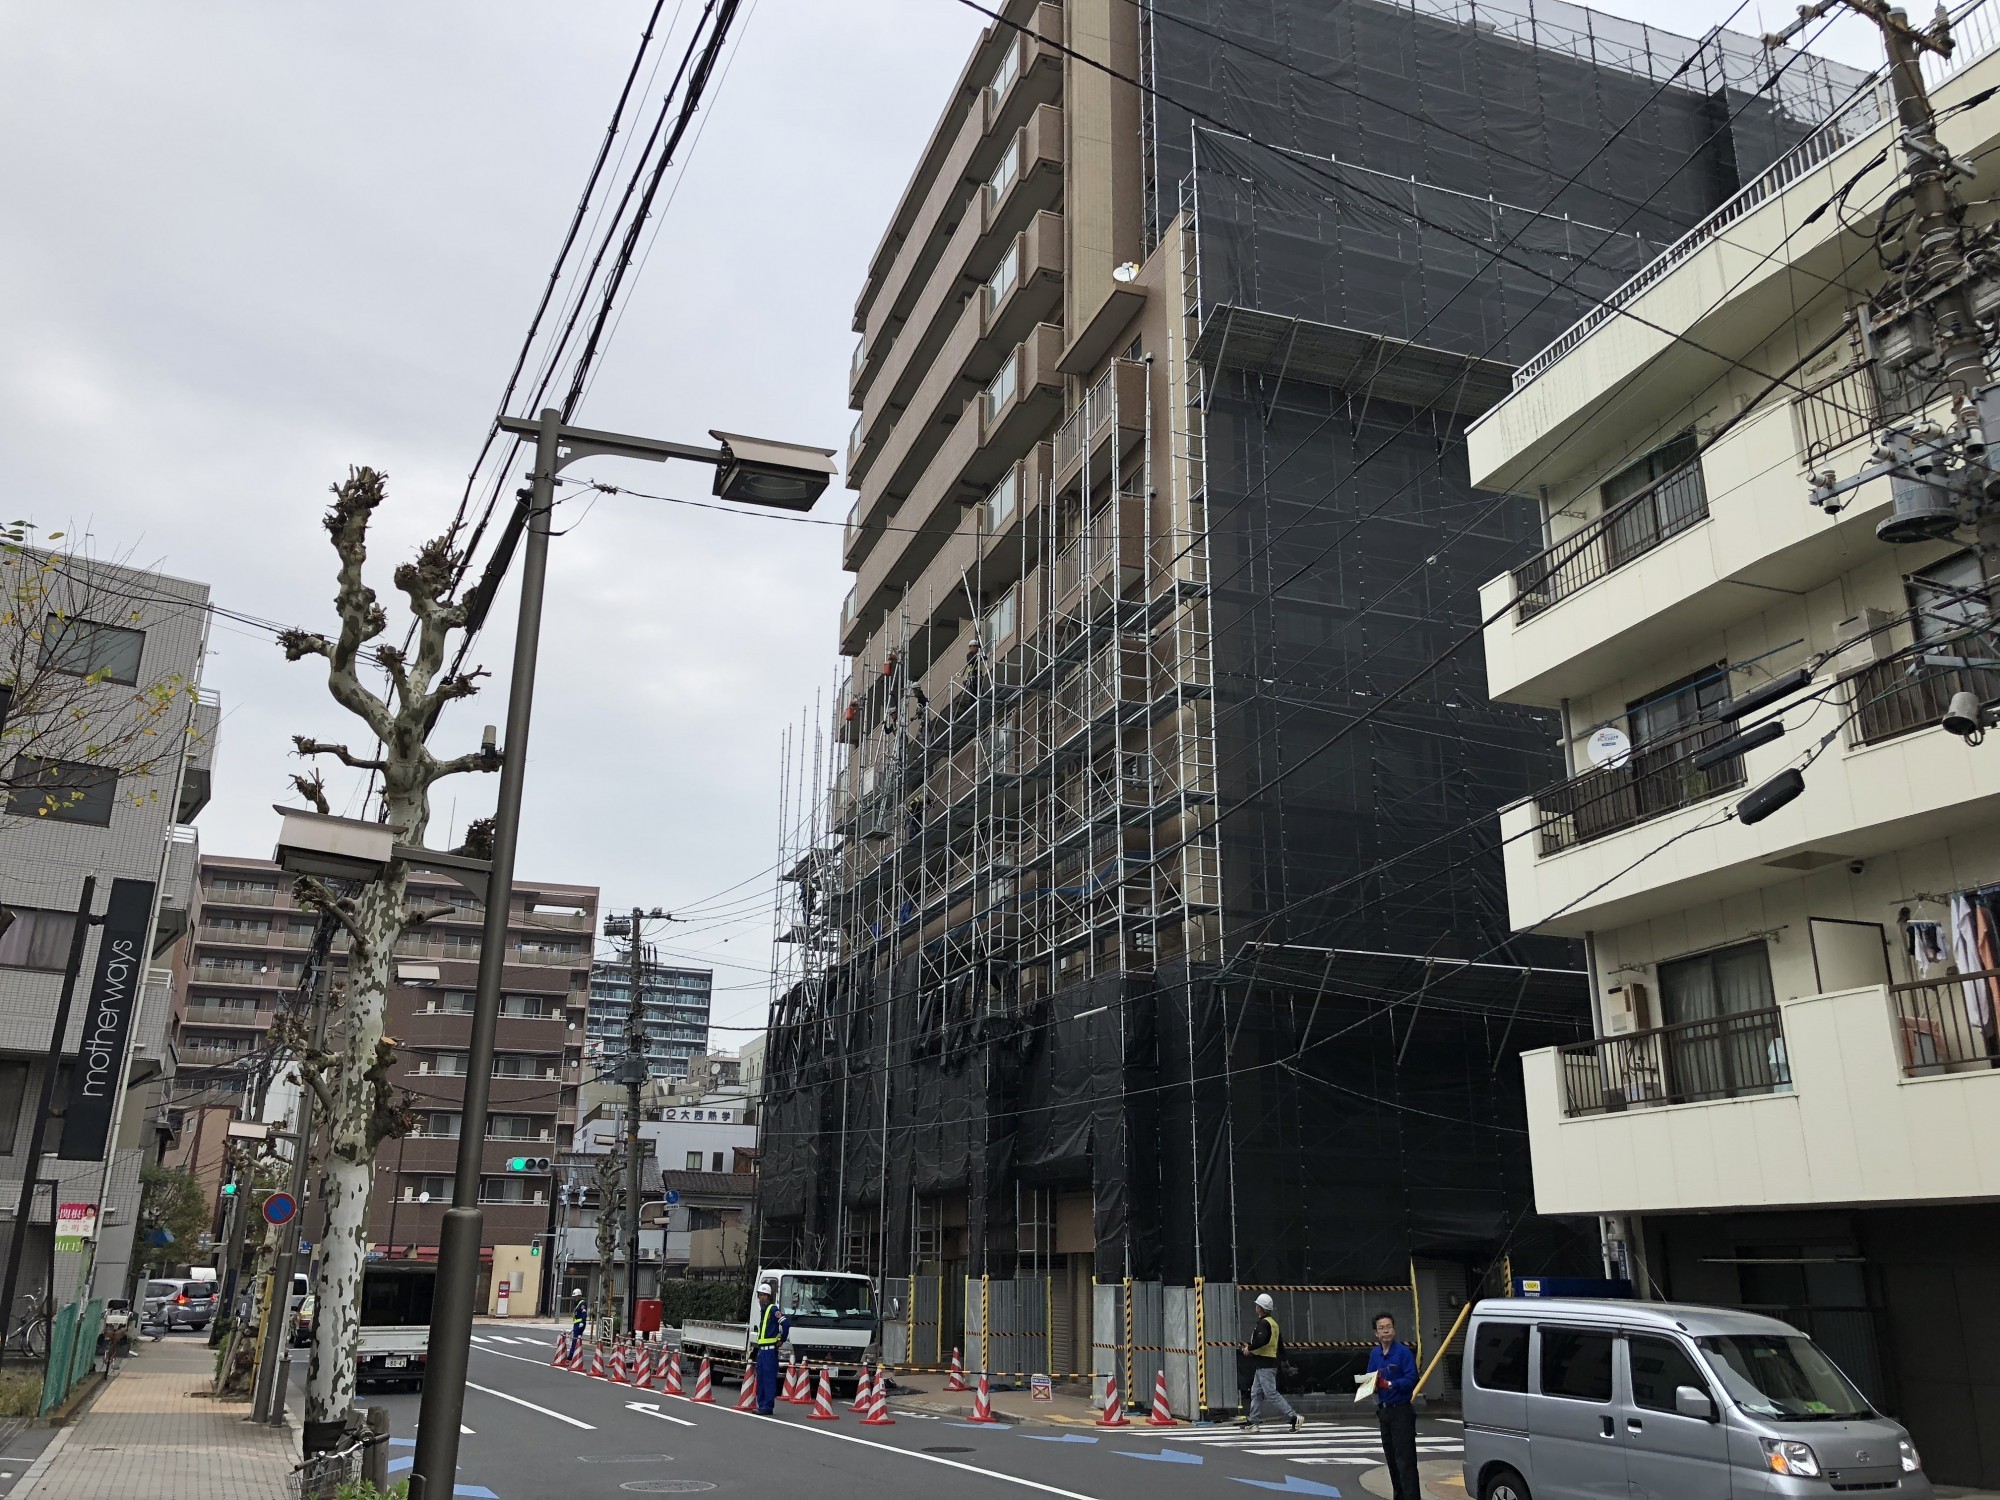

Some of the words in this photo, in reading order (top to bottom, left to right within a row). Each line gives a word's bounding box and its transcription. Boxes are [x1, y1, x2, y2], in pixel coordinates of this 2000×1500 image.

[83, 940, 136, 1096] motherways
[680, 1109, 731, 1121] 大西熱学
